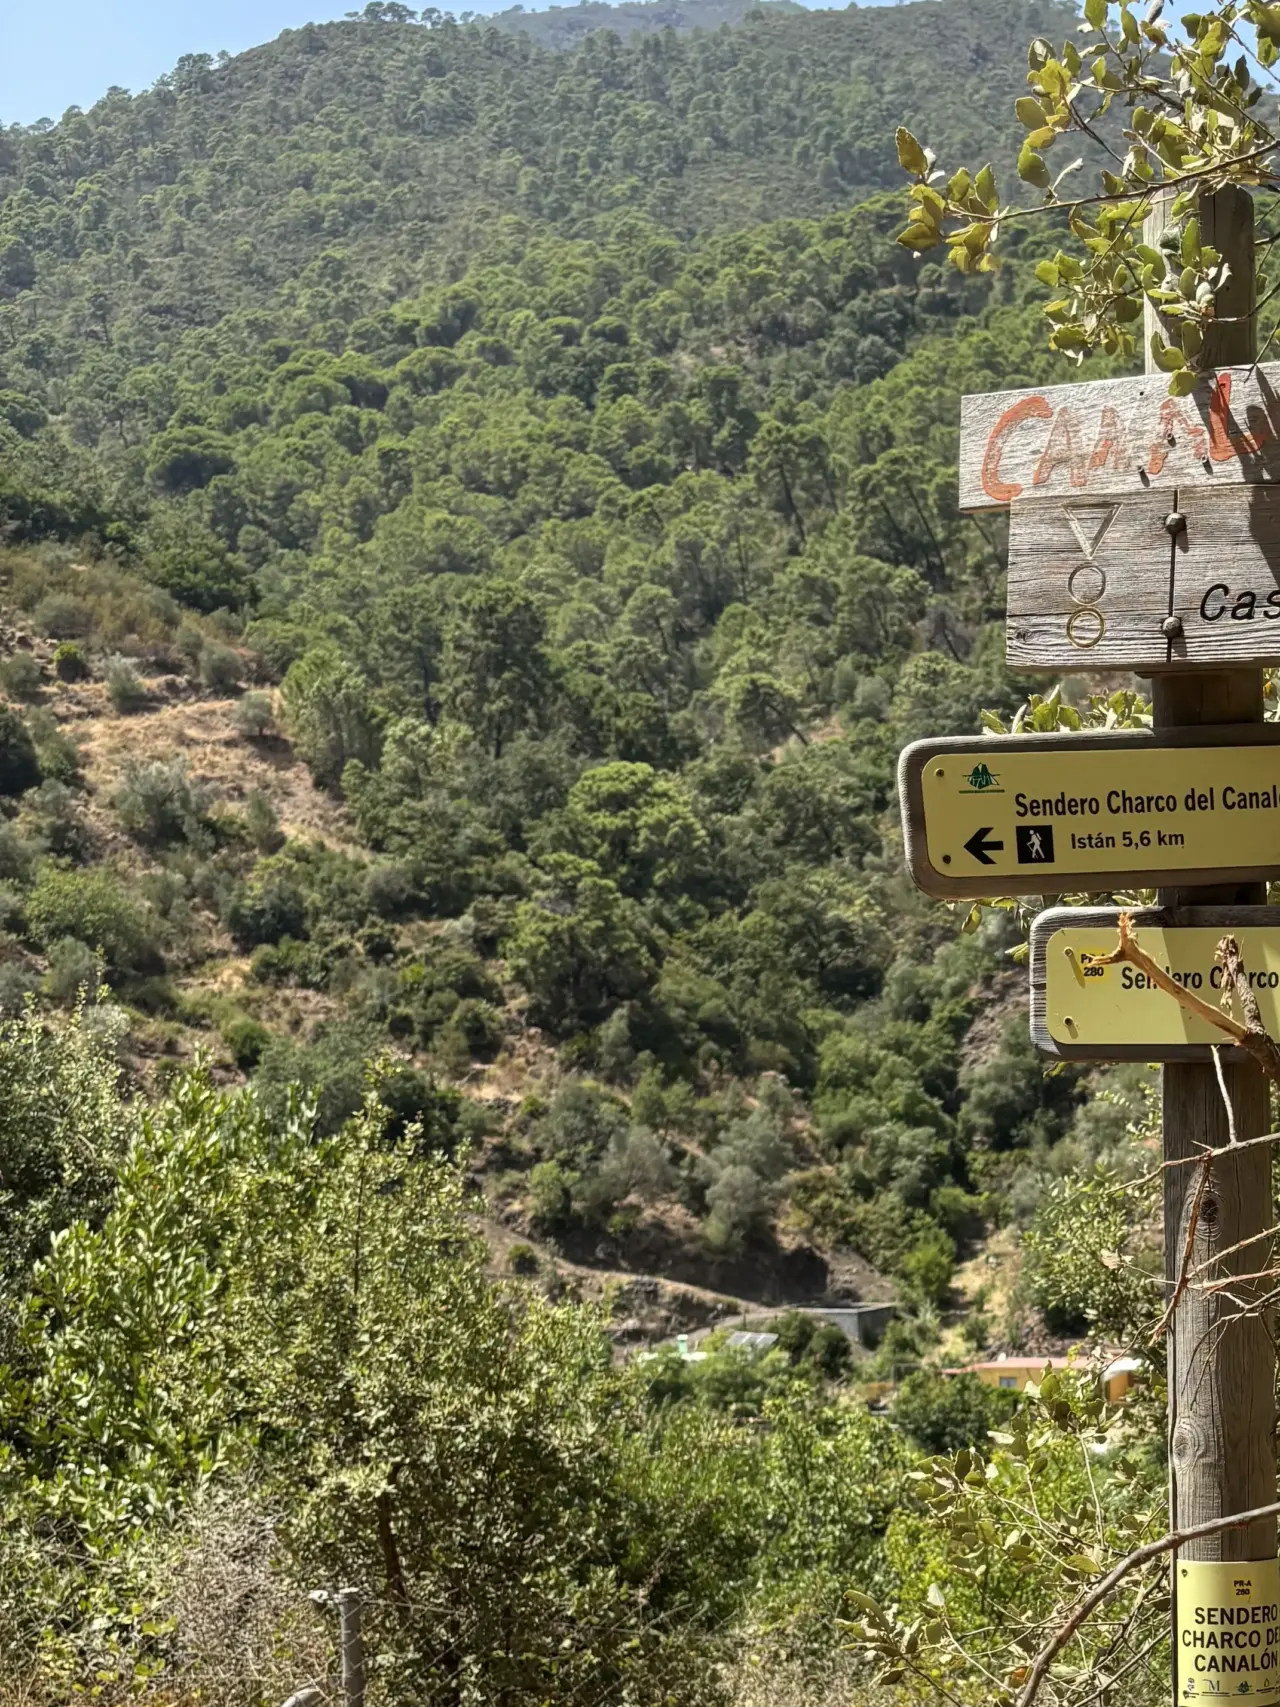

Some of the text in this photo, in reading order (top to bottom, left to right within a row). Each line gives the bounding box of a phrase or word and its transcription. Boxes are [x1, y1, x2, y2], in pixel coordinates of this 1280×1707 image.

[1015, 792, 1100, 817] Sendero
[1107, 789, 1177, 814] Charco
[1184, 787, 1215, 811] del
[1071, 830, 1184, 850] Istán 5,6 km
[1083, 966, 1104, 977] 280
[1209, 965, 1279, 989] Crco
[1194, 1604, 1278, 1625] SENDERO
[1182, 1630, 1261, 1649] CHARCO
[1194, 1648, 1278, 1673] CANALÓN
